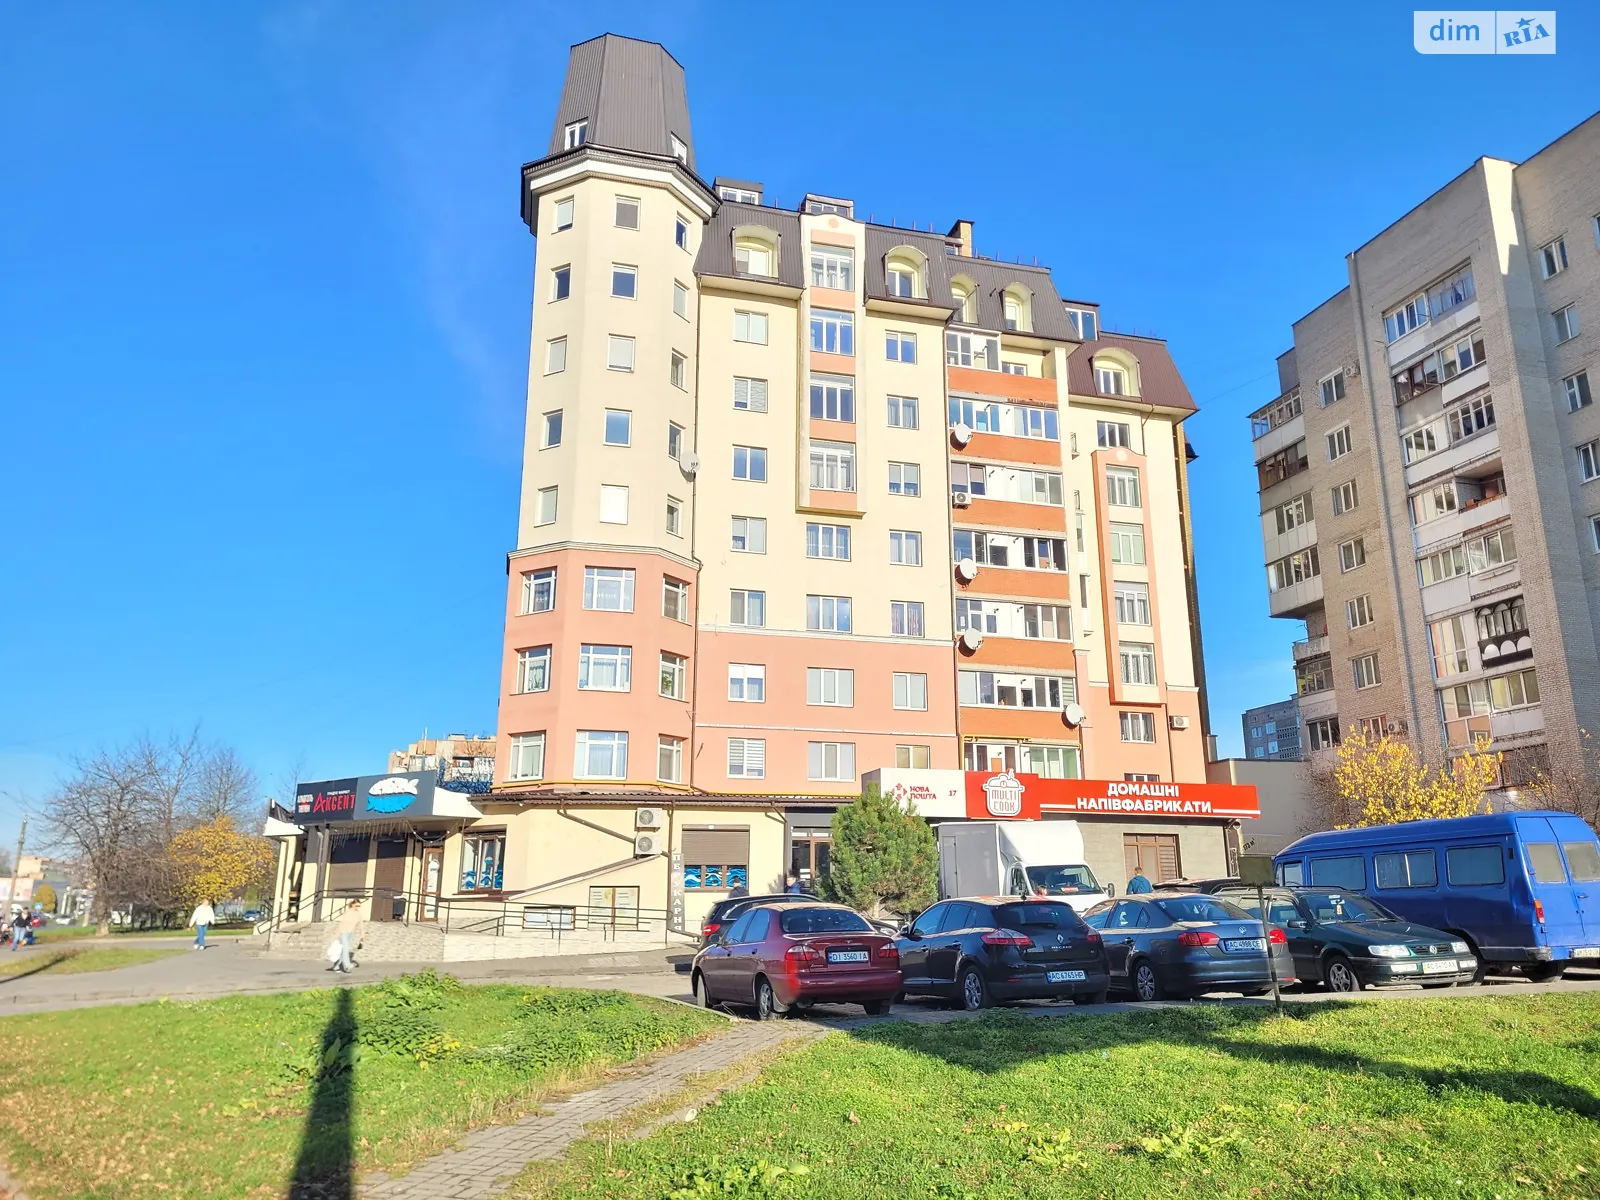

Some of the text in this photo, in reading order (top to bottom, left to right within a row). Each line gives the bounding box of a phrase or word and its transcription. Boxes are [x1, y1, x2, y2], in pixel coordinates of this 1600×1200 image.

[991, 789, 1017, 801] MULTI
[1107, 783, 1179, 798] ДОМАШНІ
[993, 801, 1015, 812] COOK
[1076, 798, 1213, 813] НАПІВФАБРИКАТИ
